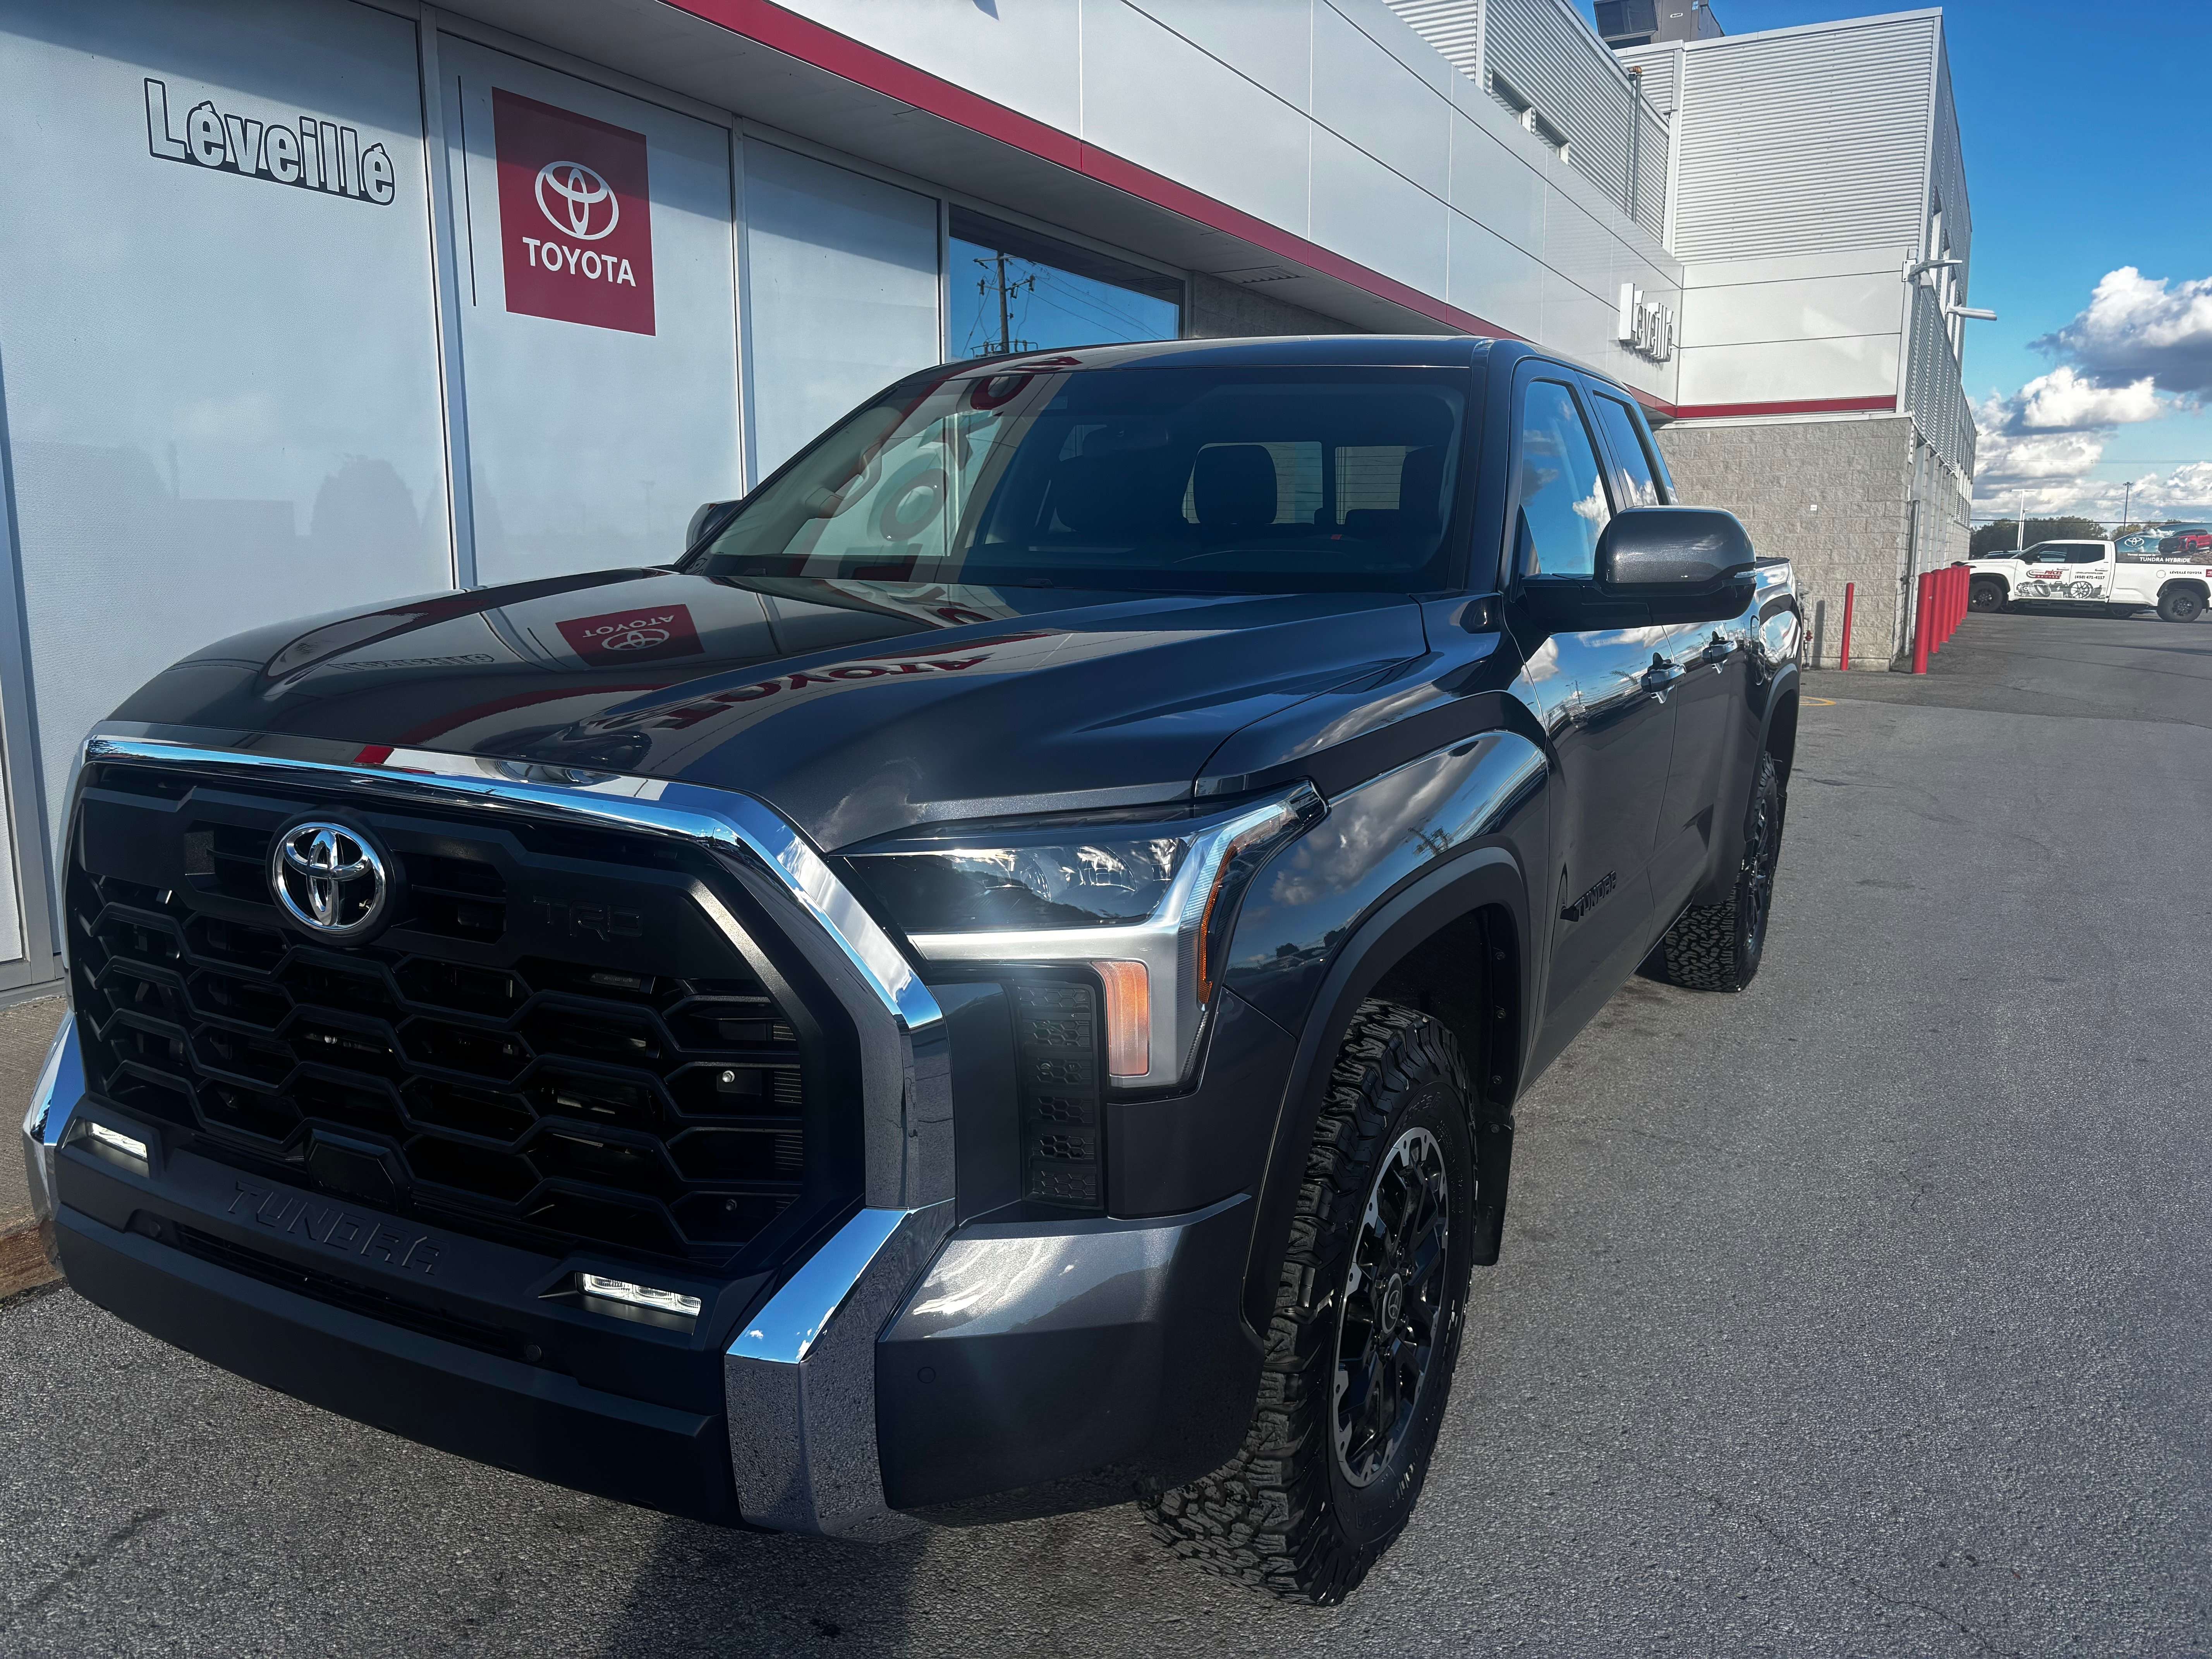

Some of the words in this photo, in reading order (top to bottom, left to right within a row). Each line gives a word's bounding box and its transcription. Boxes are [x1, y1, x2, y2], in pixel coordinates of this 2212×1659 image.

[144, 77, 395, 206] Léveillé
[522, 237, 636, 287] TOYOTA
[533, 895, 643, 942] TRD
[1573, 870, 1617, 917] TUNDRA
[228, 1180, 450, 1276] TUNDRA
